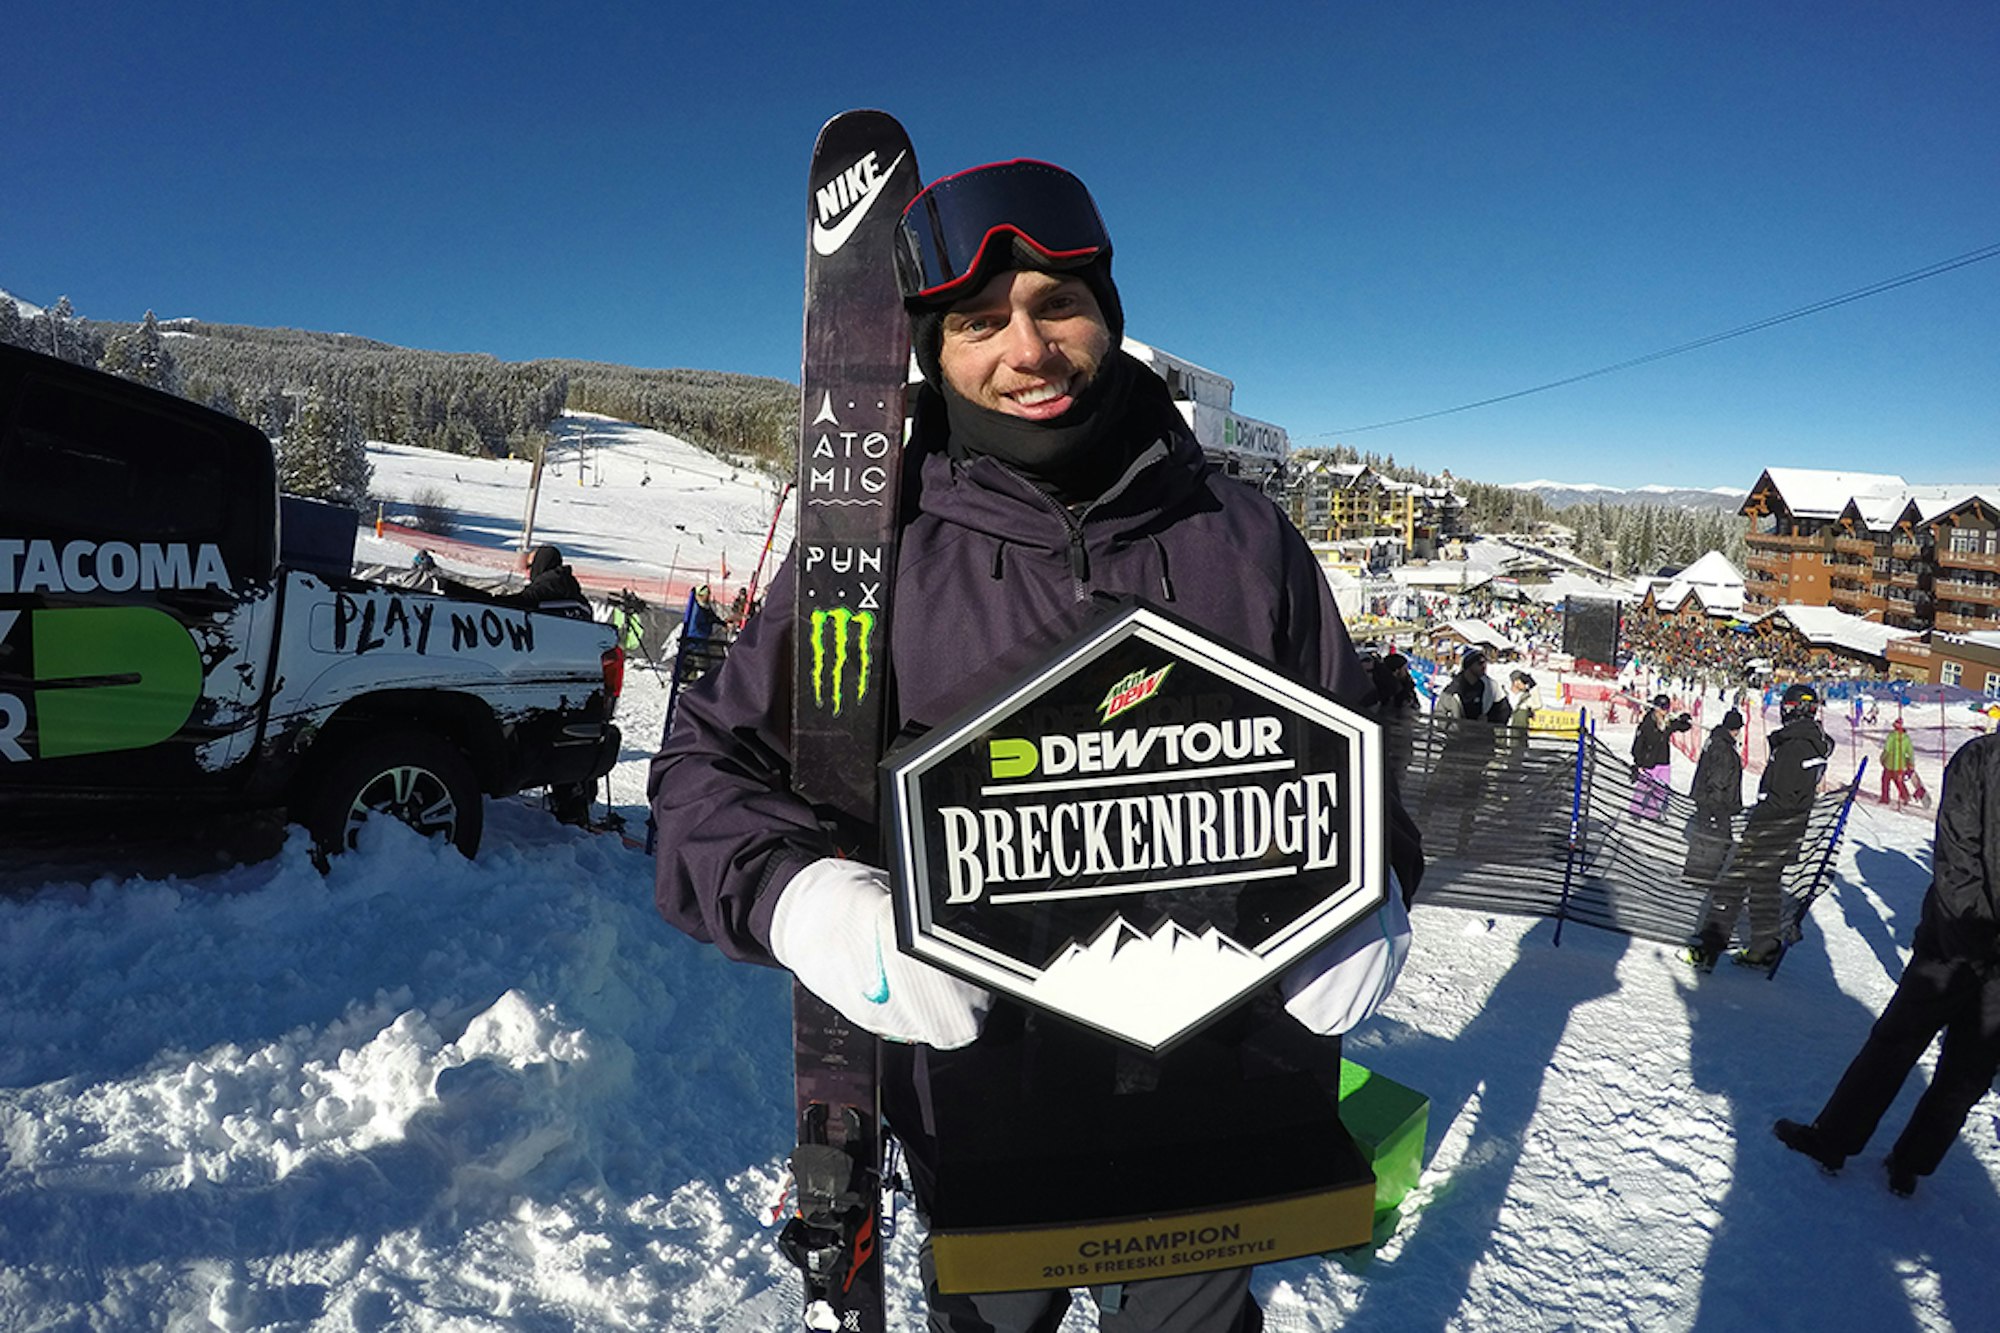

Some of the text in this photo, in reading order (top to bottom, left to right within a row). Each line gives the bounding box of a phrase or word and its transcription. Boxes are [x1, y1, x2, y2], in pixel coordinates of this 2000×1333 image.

[815, 151, 883, 225] NIKE
[0, 539, 233, 593] TACOMA
[334, 592, 535, 655] PLAY NOW
[938, 772, 1339, 905] BRECKENRIDGE
[1042, 1238, 1276, 1278] 2015 FREESKI SLOPESTYLE
[1079, 1223, 1241, 1258] CHAMPION
